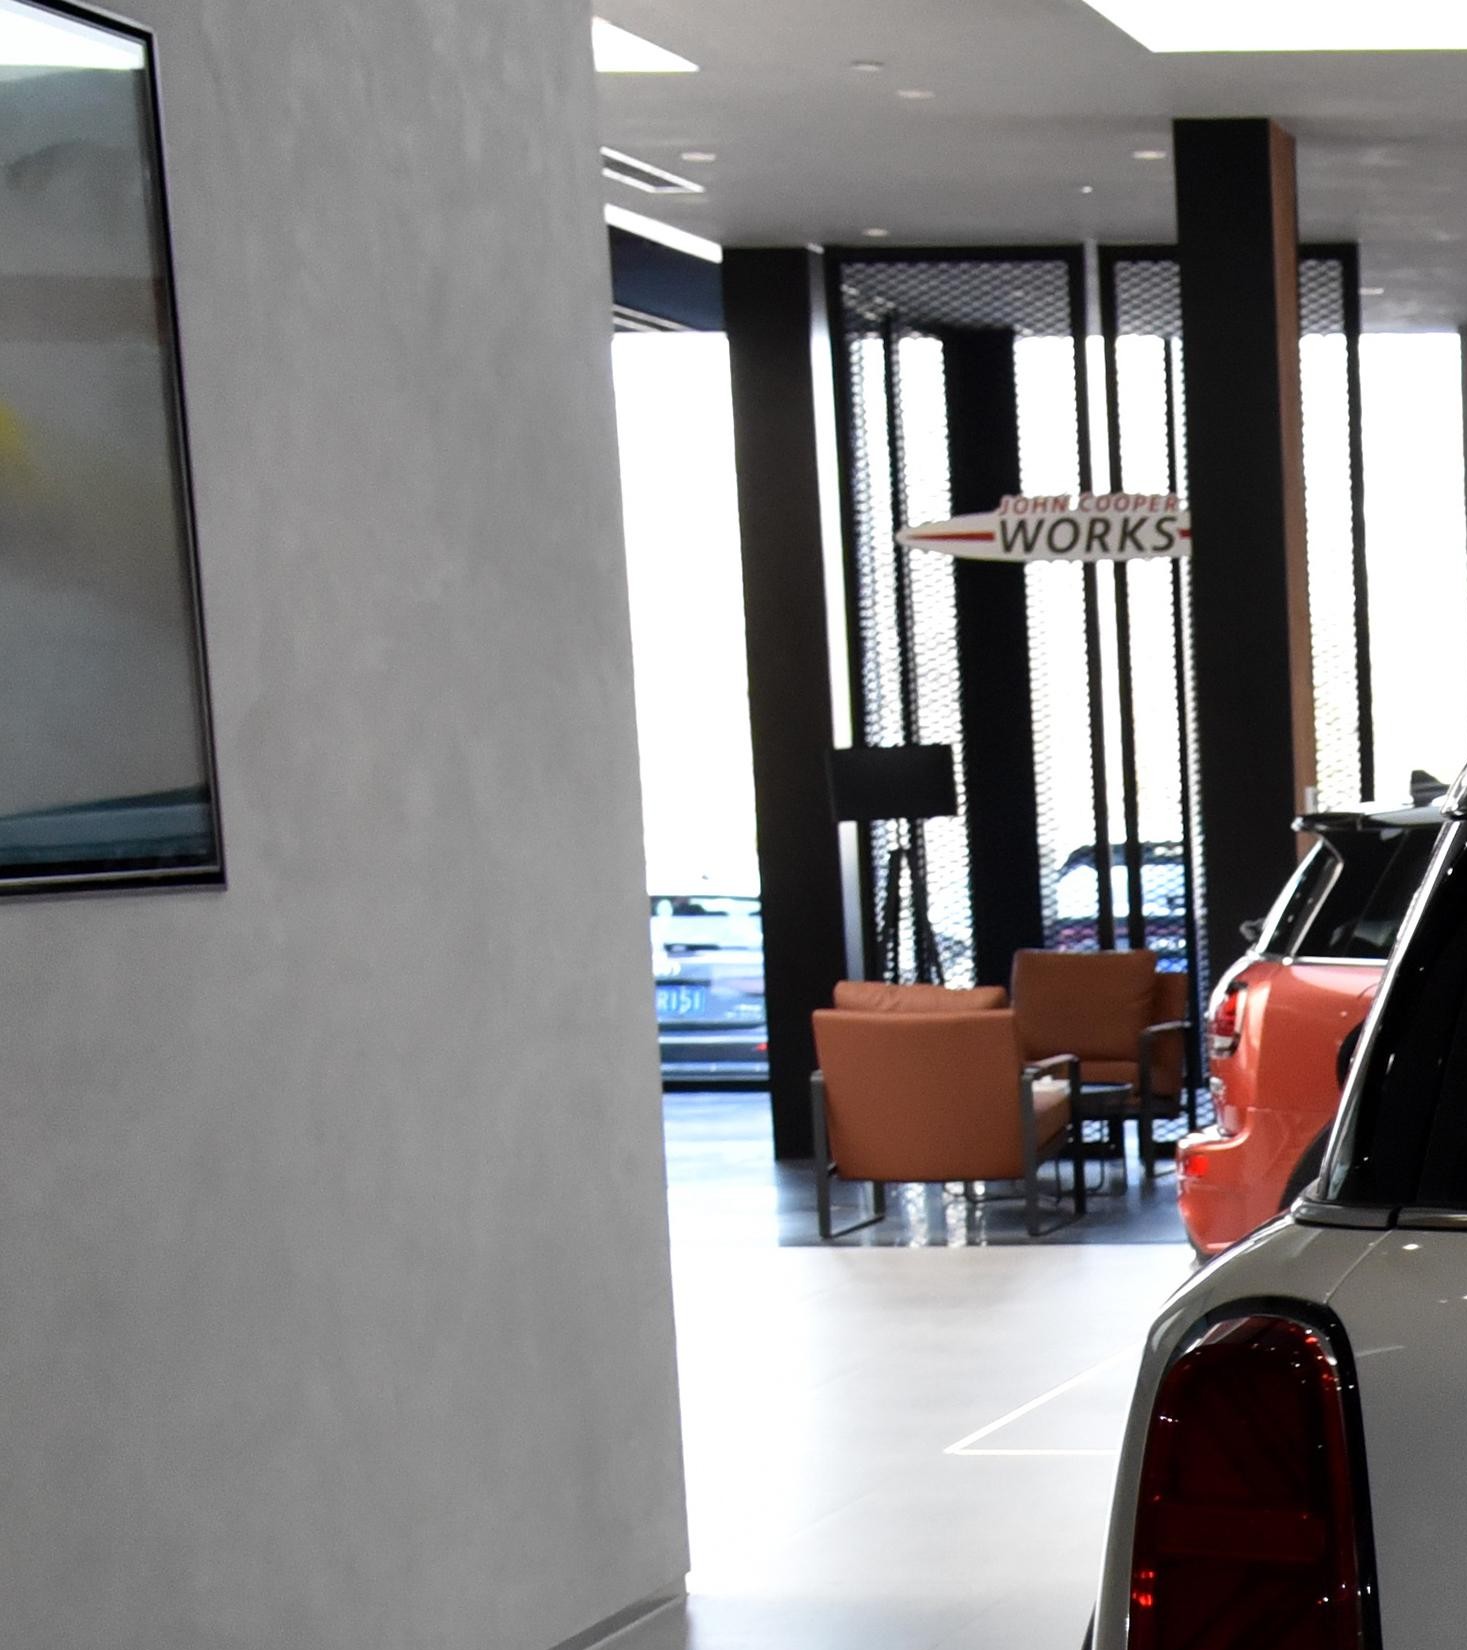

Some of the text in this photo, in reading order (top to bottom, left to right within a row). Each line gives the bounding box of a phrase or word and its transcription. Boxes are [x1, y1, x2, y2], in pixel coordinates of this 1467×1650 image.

[1001, 493, 1178, 516] JOHN COOPER
[1001, 516, 1177, 553] WORKS
